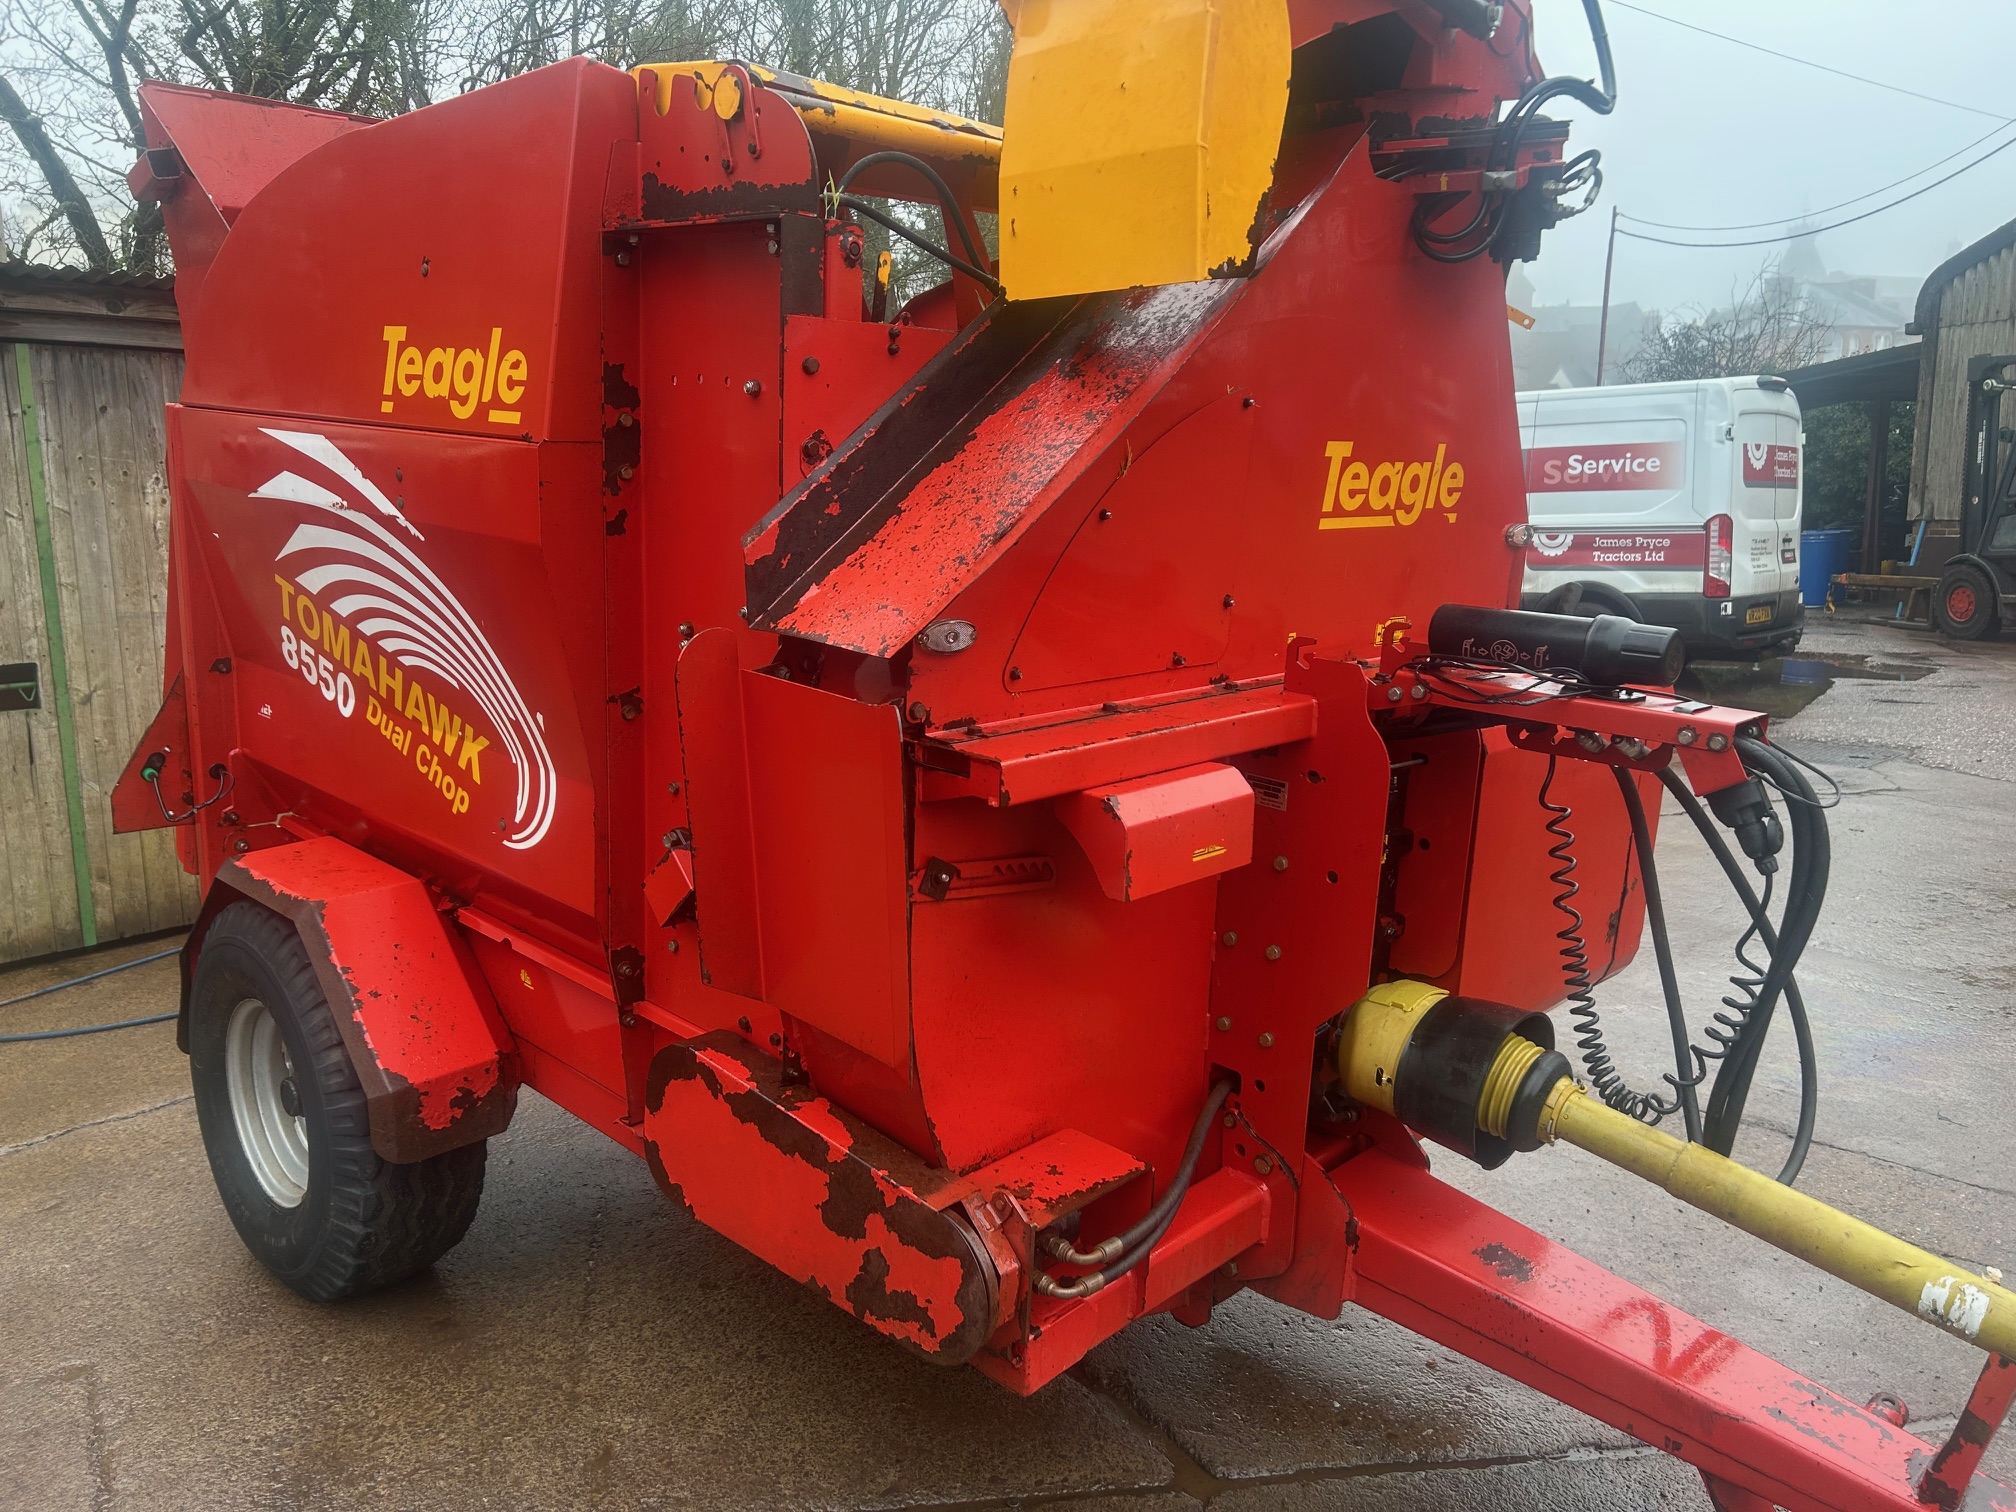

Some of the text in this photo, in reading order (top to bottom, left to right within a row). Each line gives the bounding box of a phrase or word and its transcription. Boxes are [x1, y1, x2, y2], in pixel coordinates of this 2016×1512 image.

[382, 326, 528, 422] Teagle
[1321, 440, 1465, 526] Teagle
[1567, 452, 1661, 475] Service
[1592, 537, 1671, 550] James Pryce
[1592, 551, 1664, 562] Tractors Ltd
[274, 573, 490, 785] TOMAHAWK
[280, 625, 356, 719] 8550
[365, 694, 470, 815] Dual Chop
